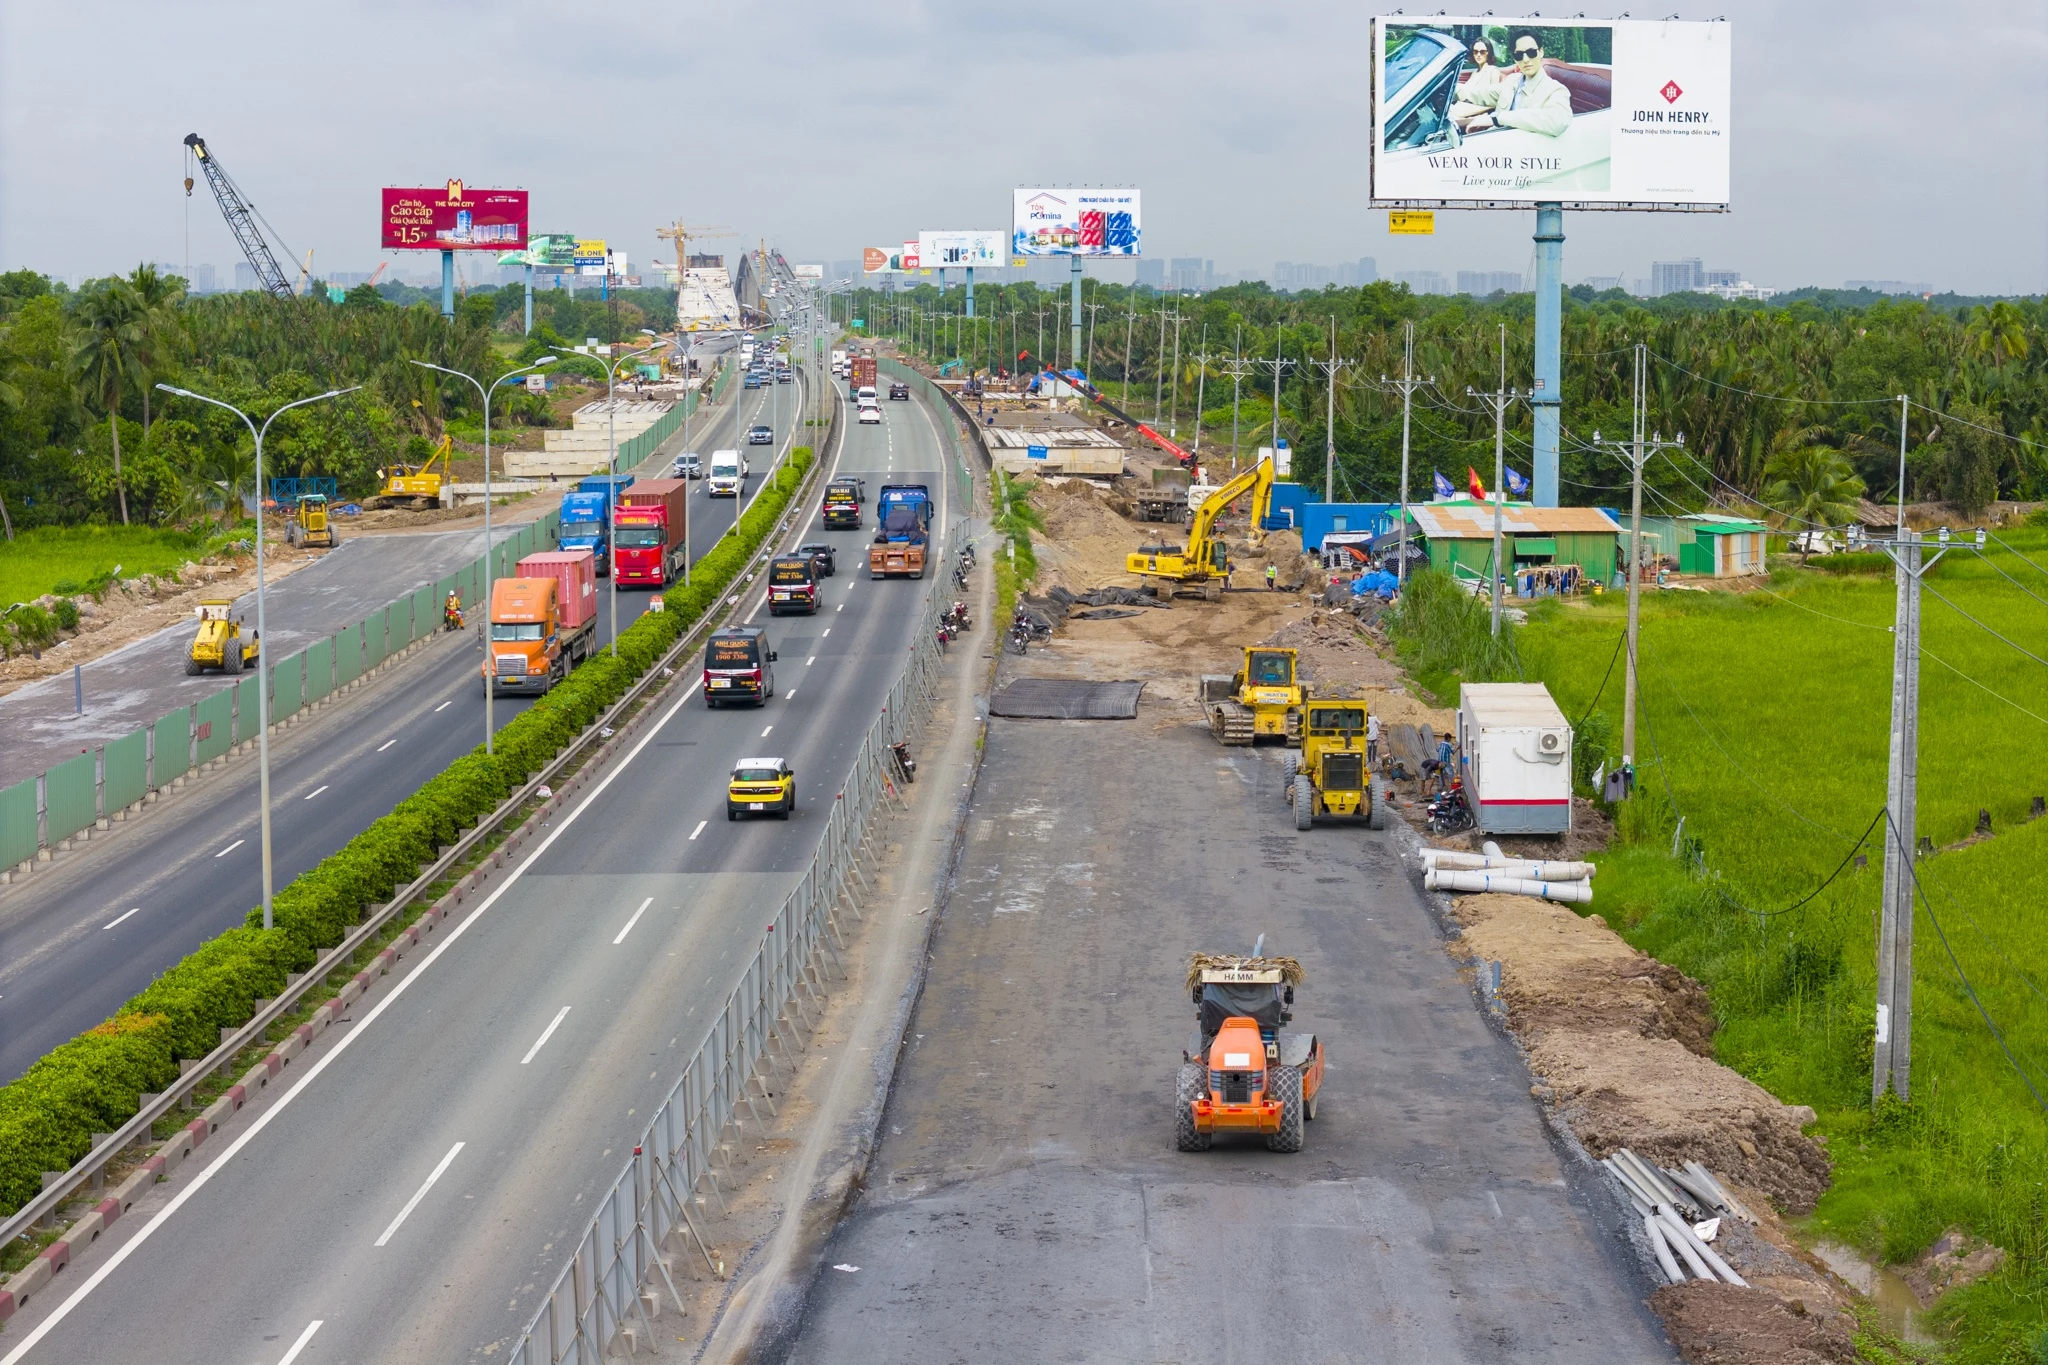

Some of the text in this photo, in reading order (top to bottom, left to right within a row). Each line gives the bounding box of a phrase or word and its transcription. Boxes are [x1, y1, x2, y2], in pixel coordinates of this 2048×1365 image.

[1632, 110, 1709, 123] JOHN HENRY
[1428, 156, 1562, 170] WEAR YOUR STYLE
[1463, 175, 1532, 188] Live your life
[413, 199, 422, 207] hộ
[391, 204, 433, 218] Cao cấp
[390, 216, 433, 225] Giá Quốc Dân
[401, 227, 420, 244] 1,5
[729, 640, 749, 648] QUỐC
